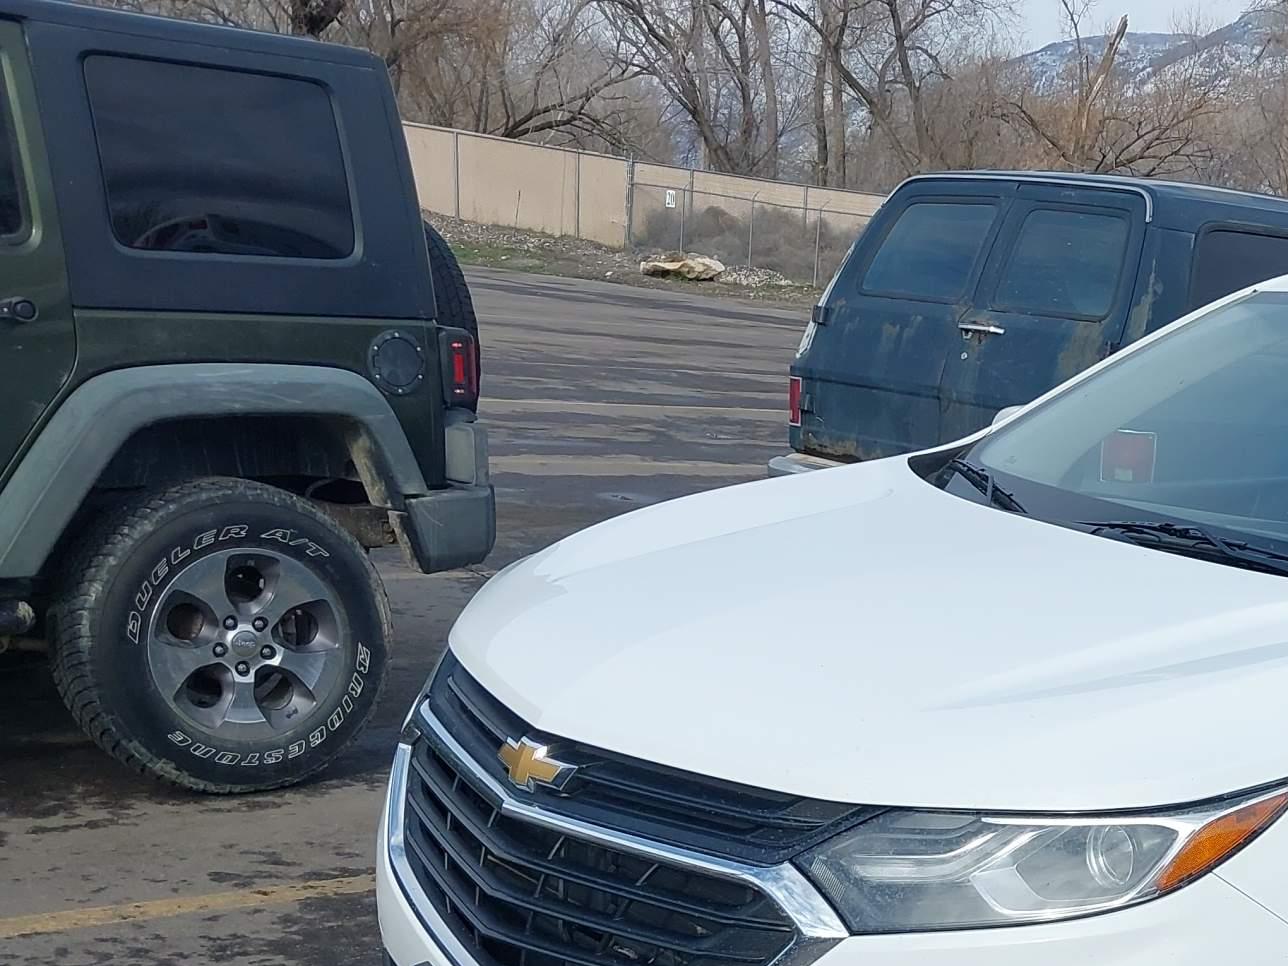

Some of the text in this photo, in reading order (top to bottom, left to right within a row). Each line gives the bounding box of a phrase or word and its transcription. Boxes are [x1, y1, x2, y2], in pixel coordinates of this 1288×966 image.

[127, 524, 330, 645] DUELER A/T
[168, 641, 371, 766] BRIDGESTONE
